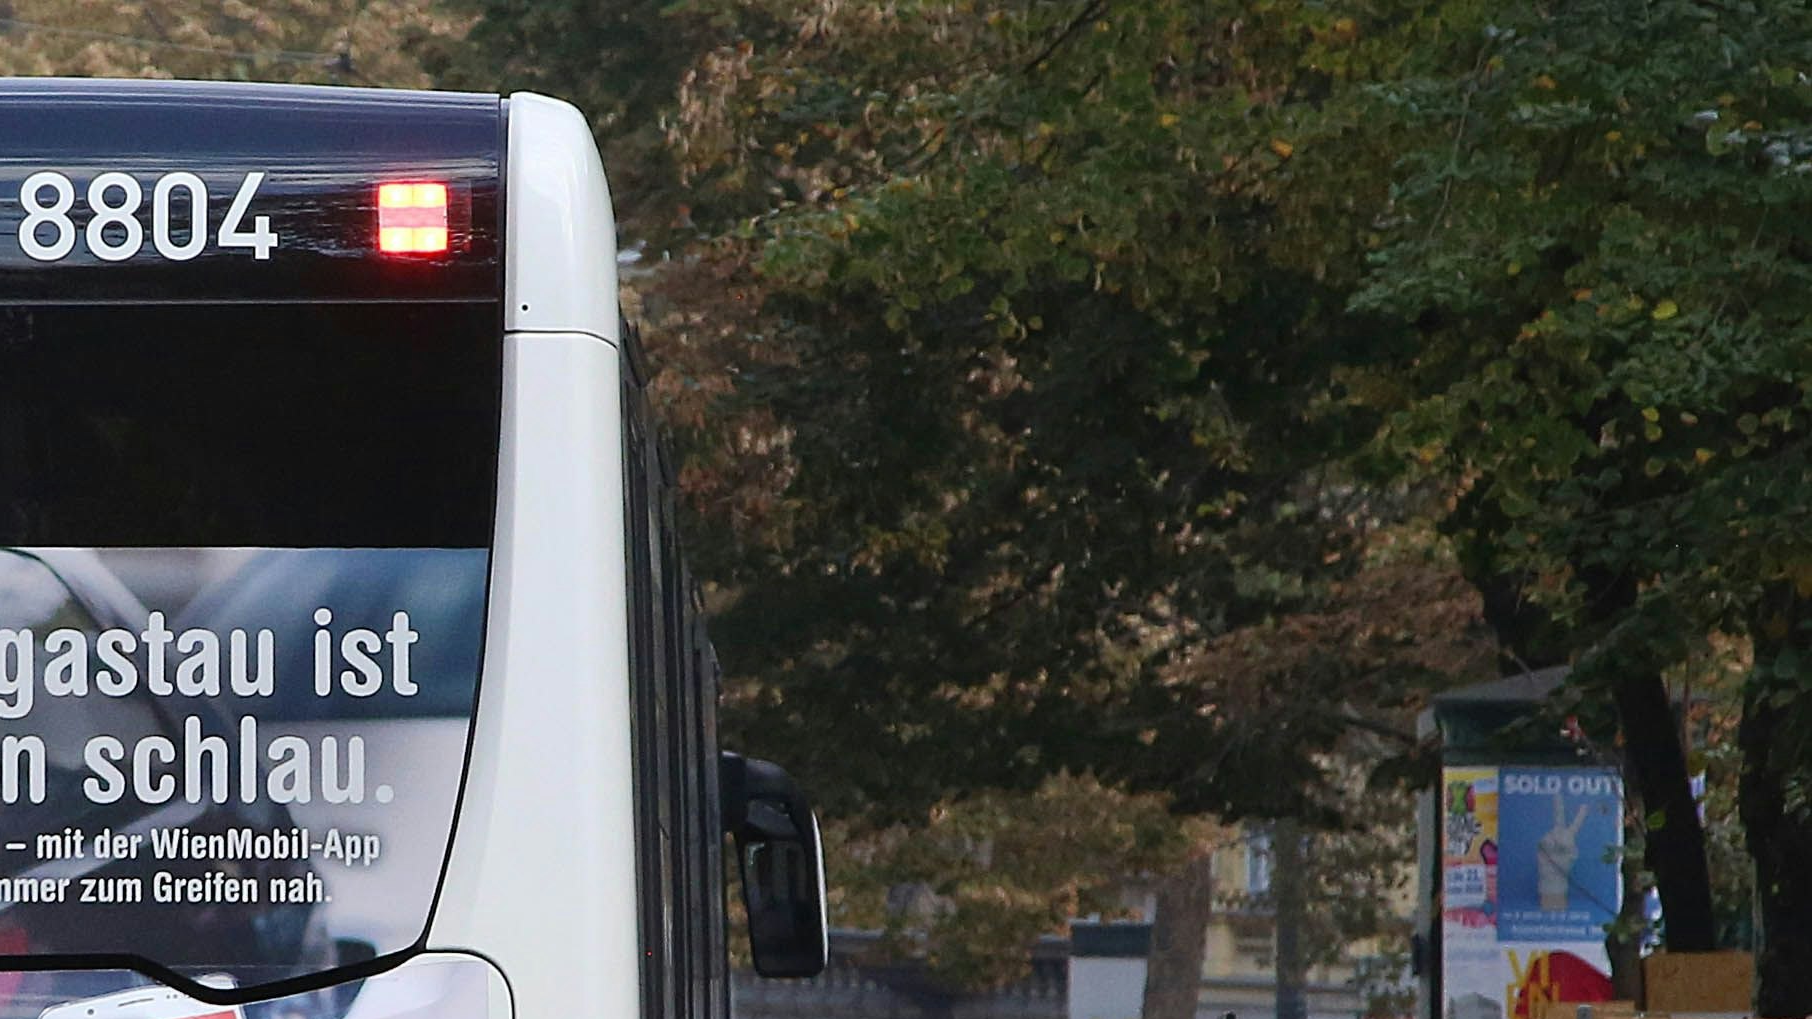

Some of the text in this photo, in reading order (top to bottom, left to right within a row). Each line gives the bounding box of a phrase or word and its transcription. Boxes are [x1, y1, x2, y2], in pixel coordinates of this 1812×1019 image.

[18, 171, 279, 261] 8804
[313, 607, 419, 697] ist
[83, 715, 394, 804] schlau.
[1505, 775, 1561, 794] SOLD
[36, 828, 84, 860] mit
[94, 828, 143, 860] der
[151, 828, 381, 867] WienMobil-App
[79, 877, 143, 904] zum
[152, 871, 259, 904] Greifen
[269, 871, 333, 904] nah.
